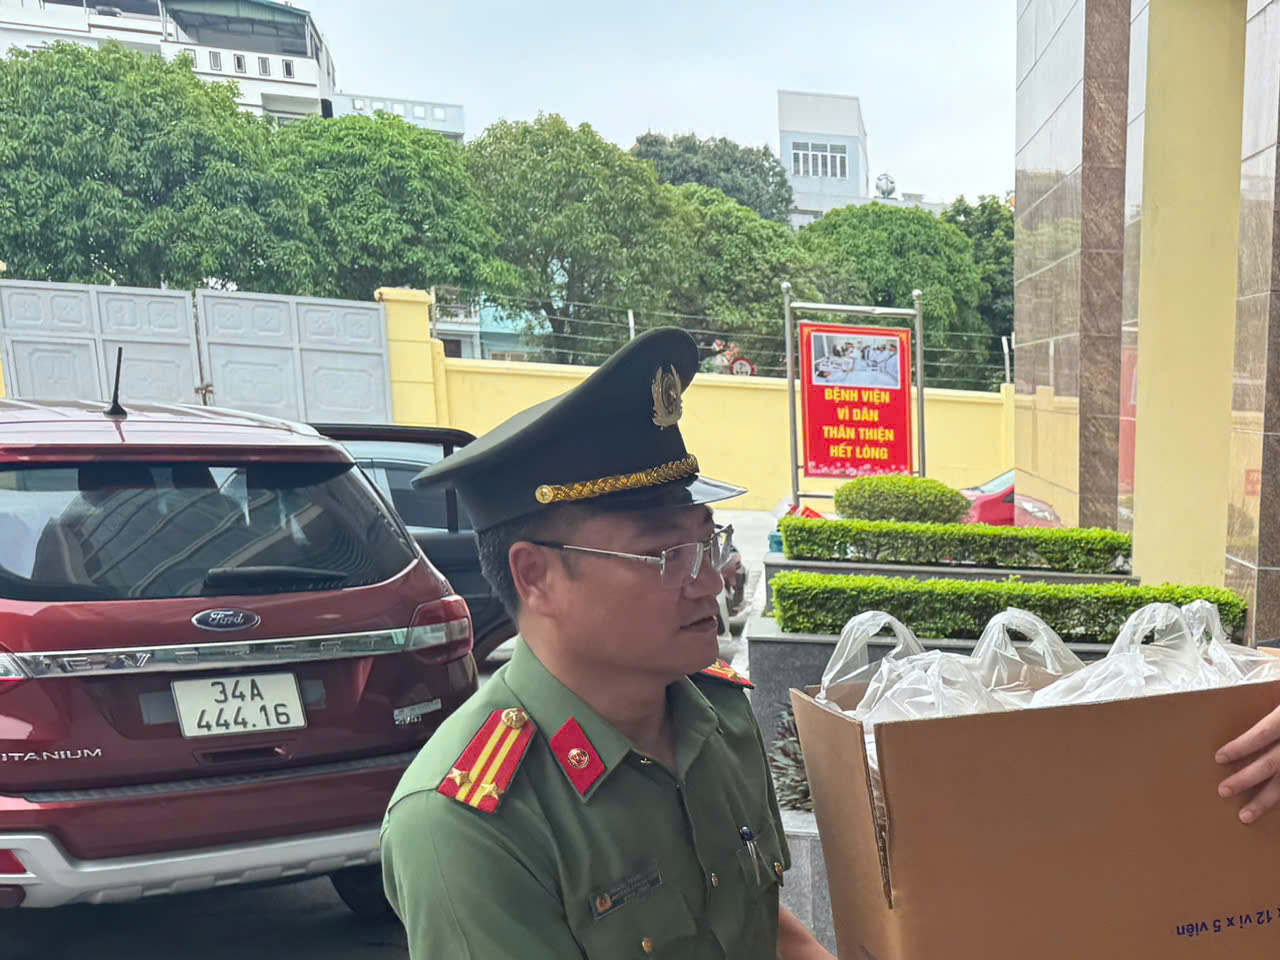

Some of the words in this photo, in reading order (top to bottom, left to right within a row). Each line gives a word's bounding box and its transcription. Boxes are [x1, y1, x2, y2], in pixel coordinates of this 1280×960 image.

[824, 387, 858, 403] BỆNH
[861, 389, 890, 405] VIỆN
[837, 405, 850, 421] VÌ
[852, 407, 879, 421] DÂN
[823, 425, 855, 439] THÂN
[858, 427, 894, 443] THIỆN
[830, 443, 852, 458] HẾT
[856, 445, 888, 459] LÒNG
[209, 611, 244, 625] Ford
[210, 679, 264, 703] 34A
[197, 703, 291, 732] 444.16
[0, 749, 102, 761] ITANIUM
[1226, 916, 1235, 927] x
[1256, 910, 1272, 925] 12
[1176, 922, 1208, 937] viên
[1213, 919, 1221, 932] 5
